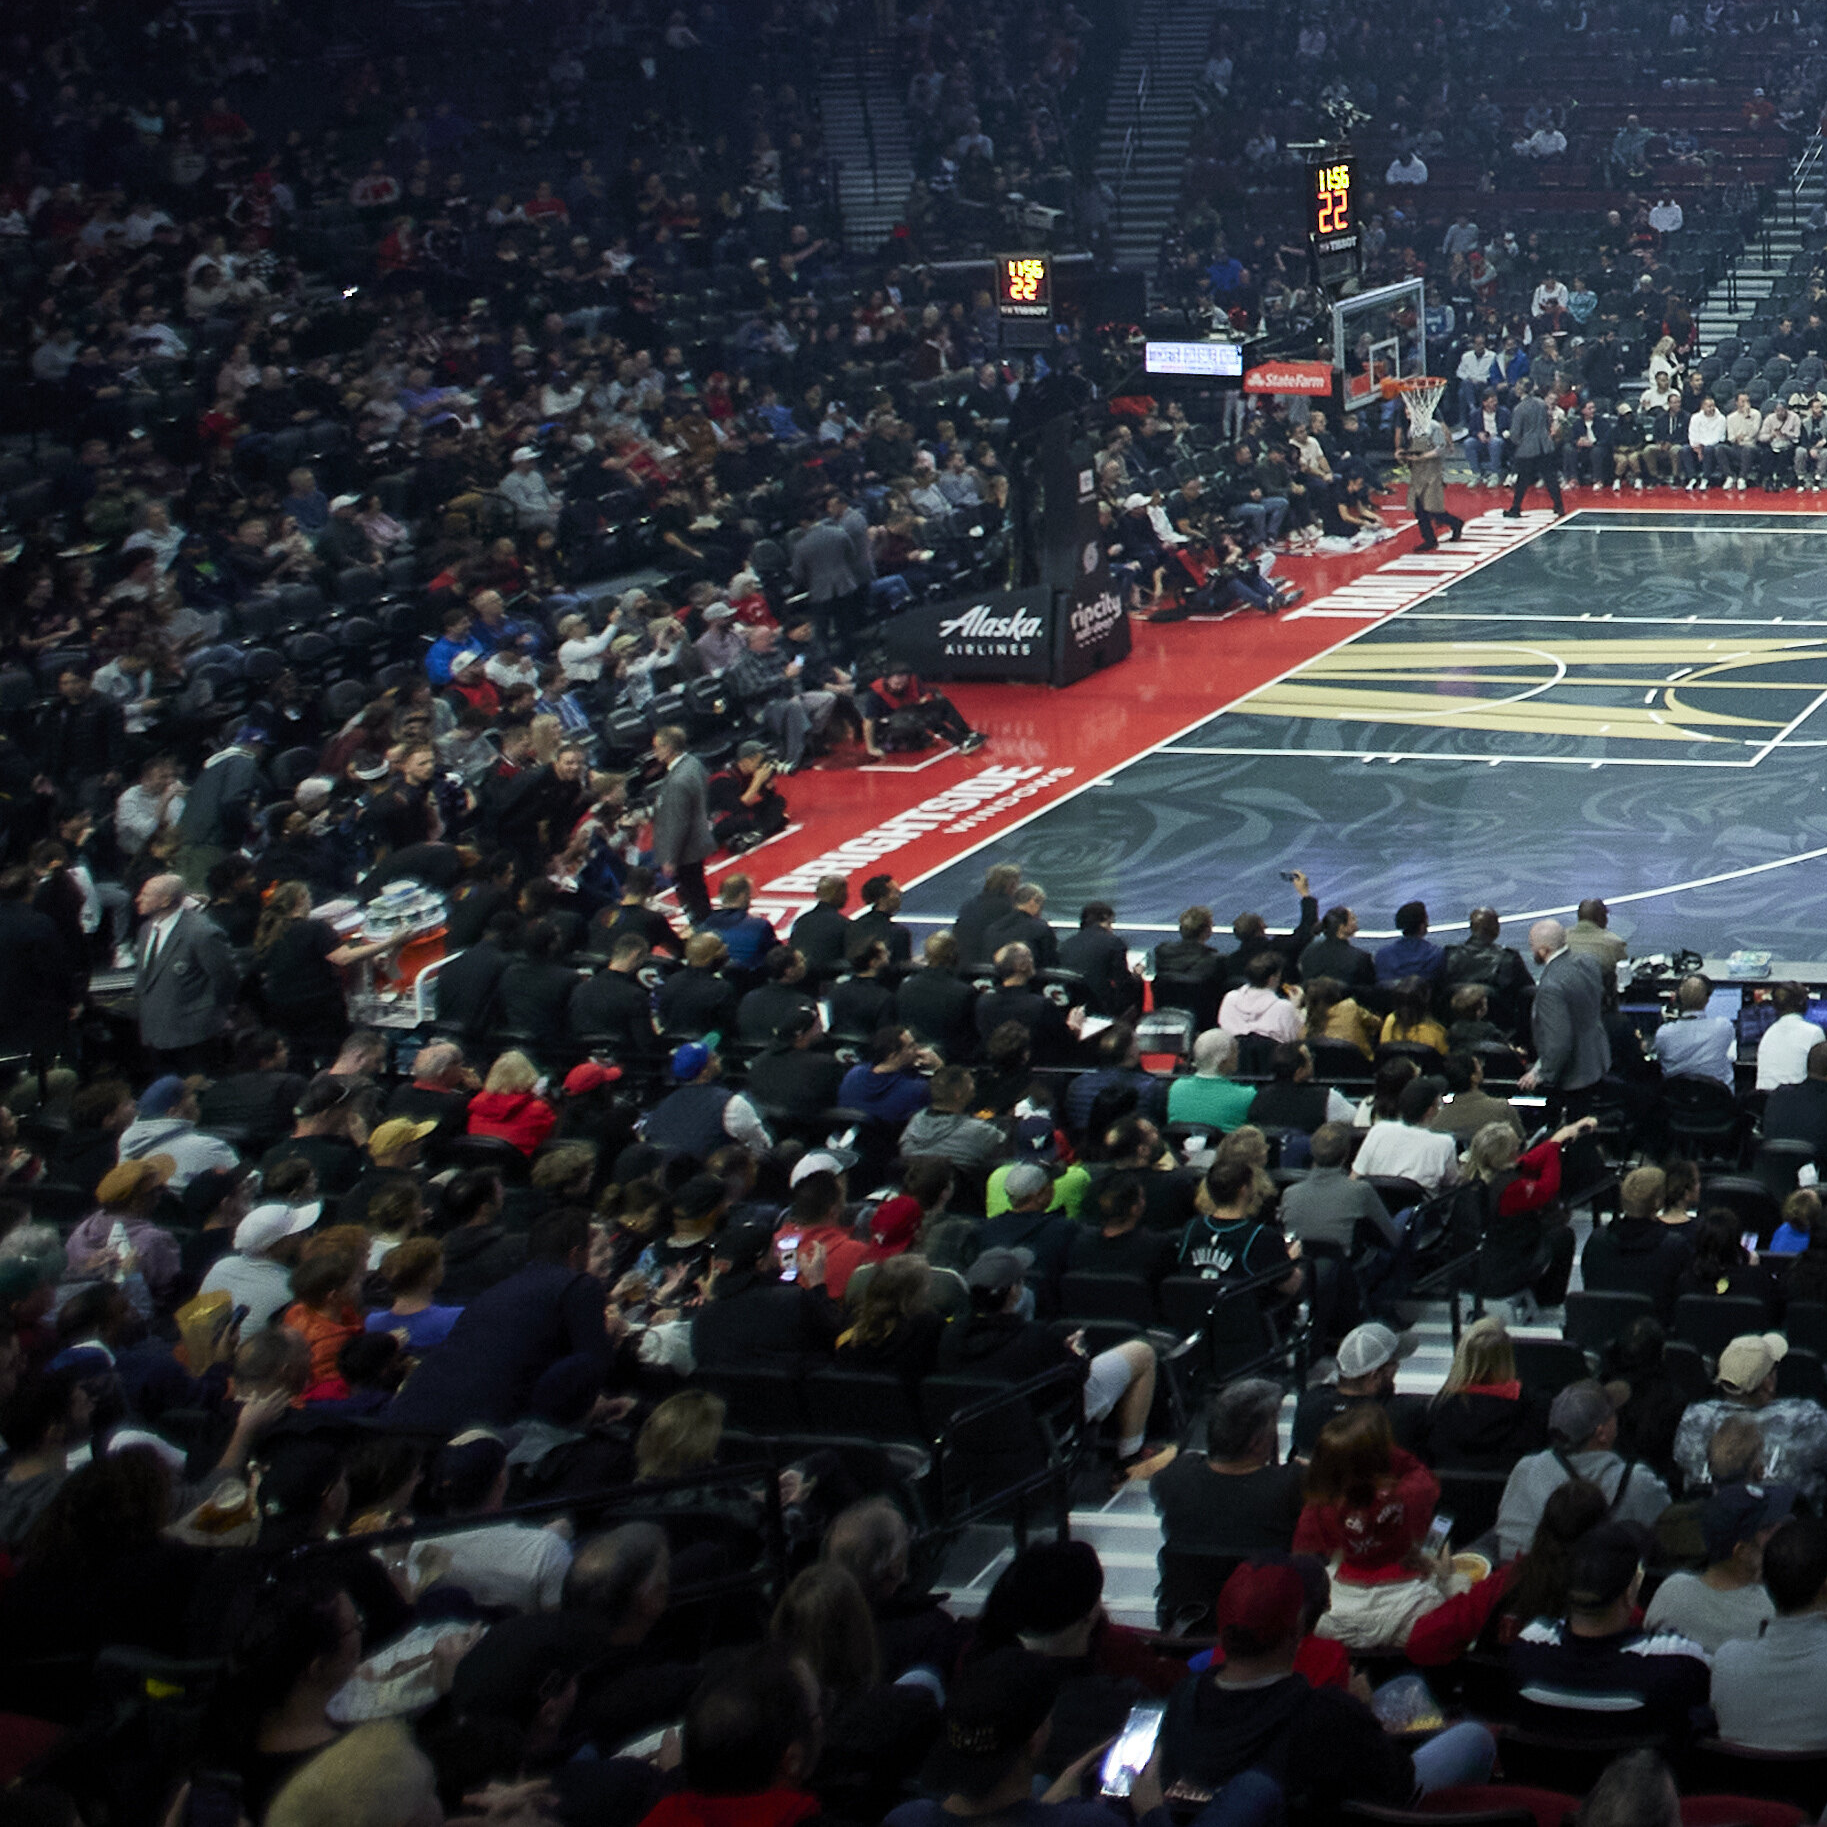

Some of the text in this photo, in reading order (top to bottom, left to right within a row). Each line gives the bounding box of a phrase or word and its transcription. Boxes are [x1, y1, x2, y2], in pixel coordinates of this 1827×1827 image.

[1317, 189, 1349, 234] 22
[1009, 275, 1039, 301] 22
[940, 604, 1038, 639] Alaska
[945, 643, 1031, 656] AIRLINES
[943, 766, 1075, 834] WINDOWS
